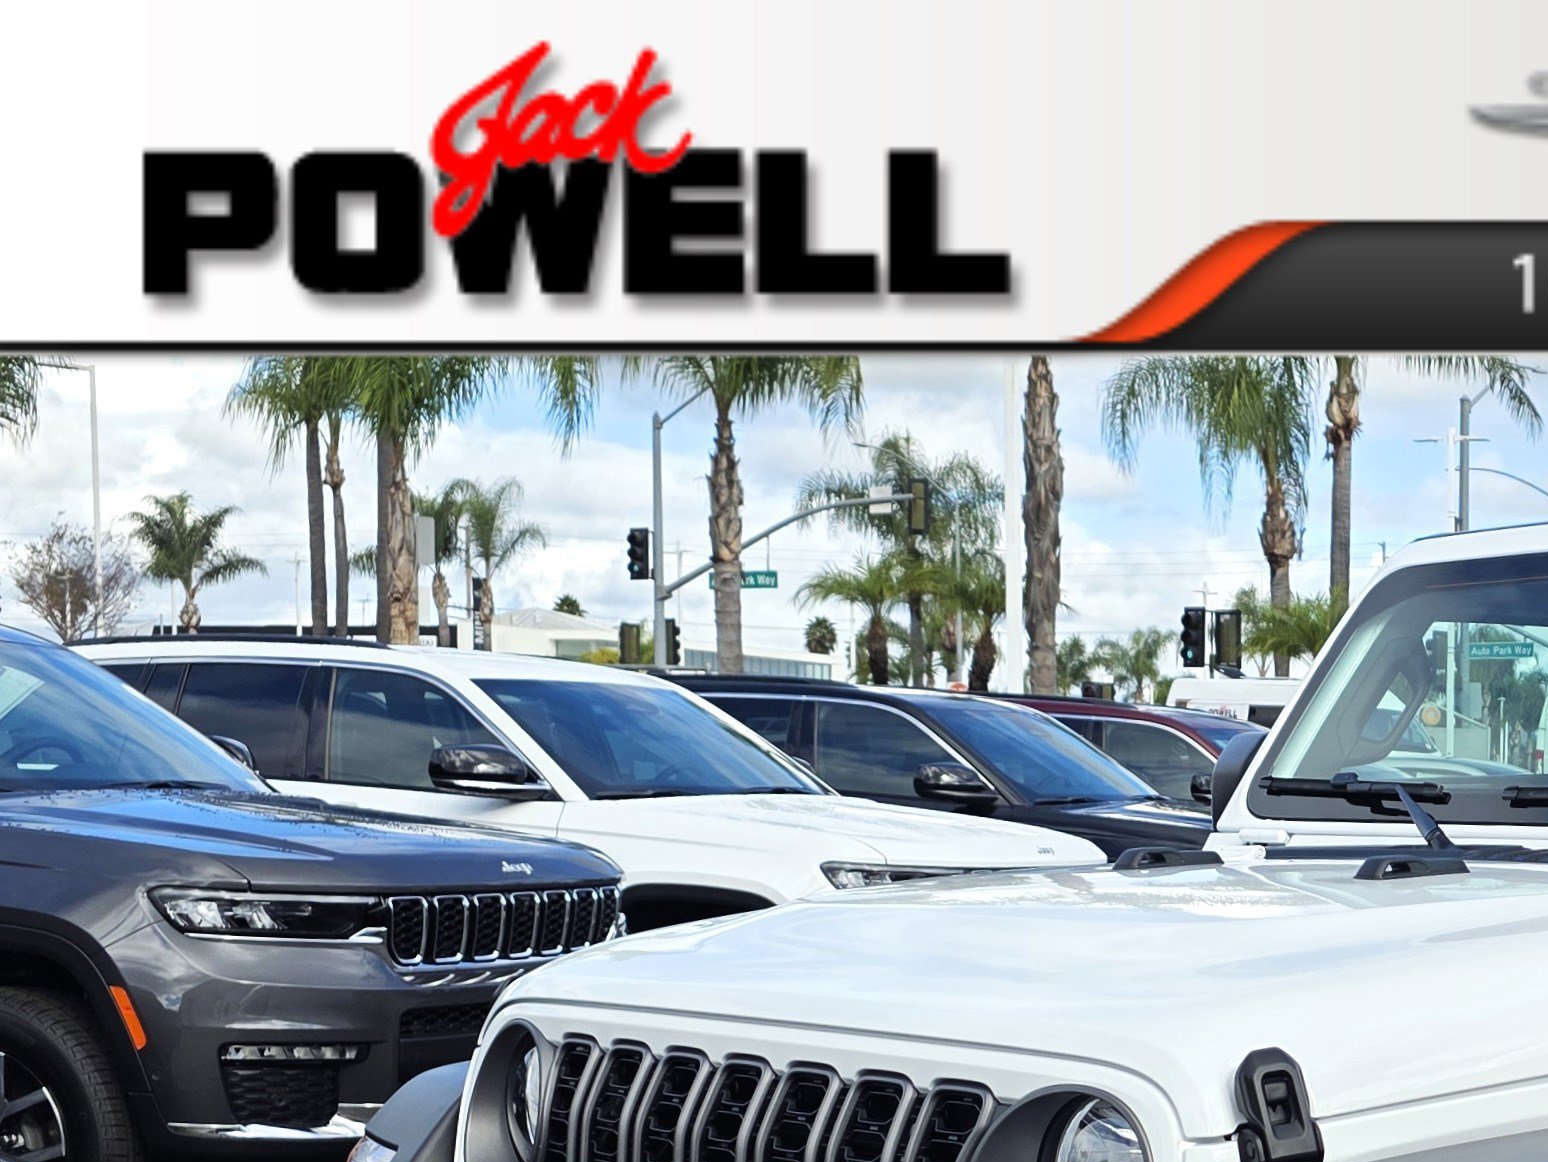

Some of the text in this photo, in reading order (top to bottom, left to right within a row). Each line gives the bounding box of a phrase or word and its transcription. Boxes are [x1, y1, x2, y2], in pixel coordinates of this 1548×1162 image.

[1471, 645, 1532, 656] Auto Park Way
